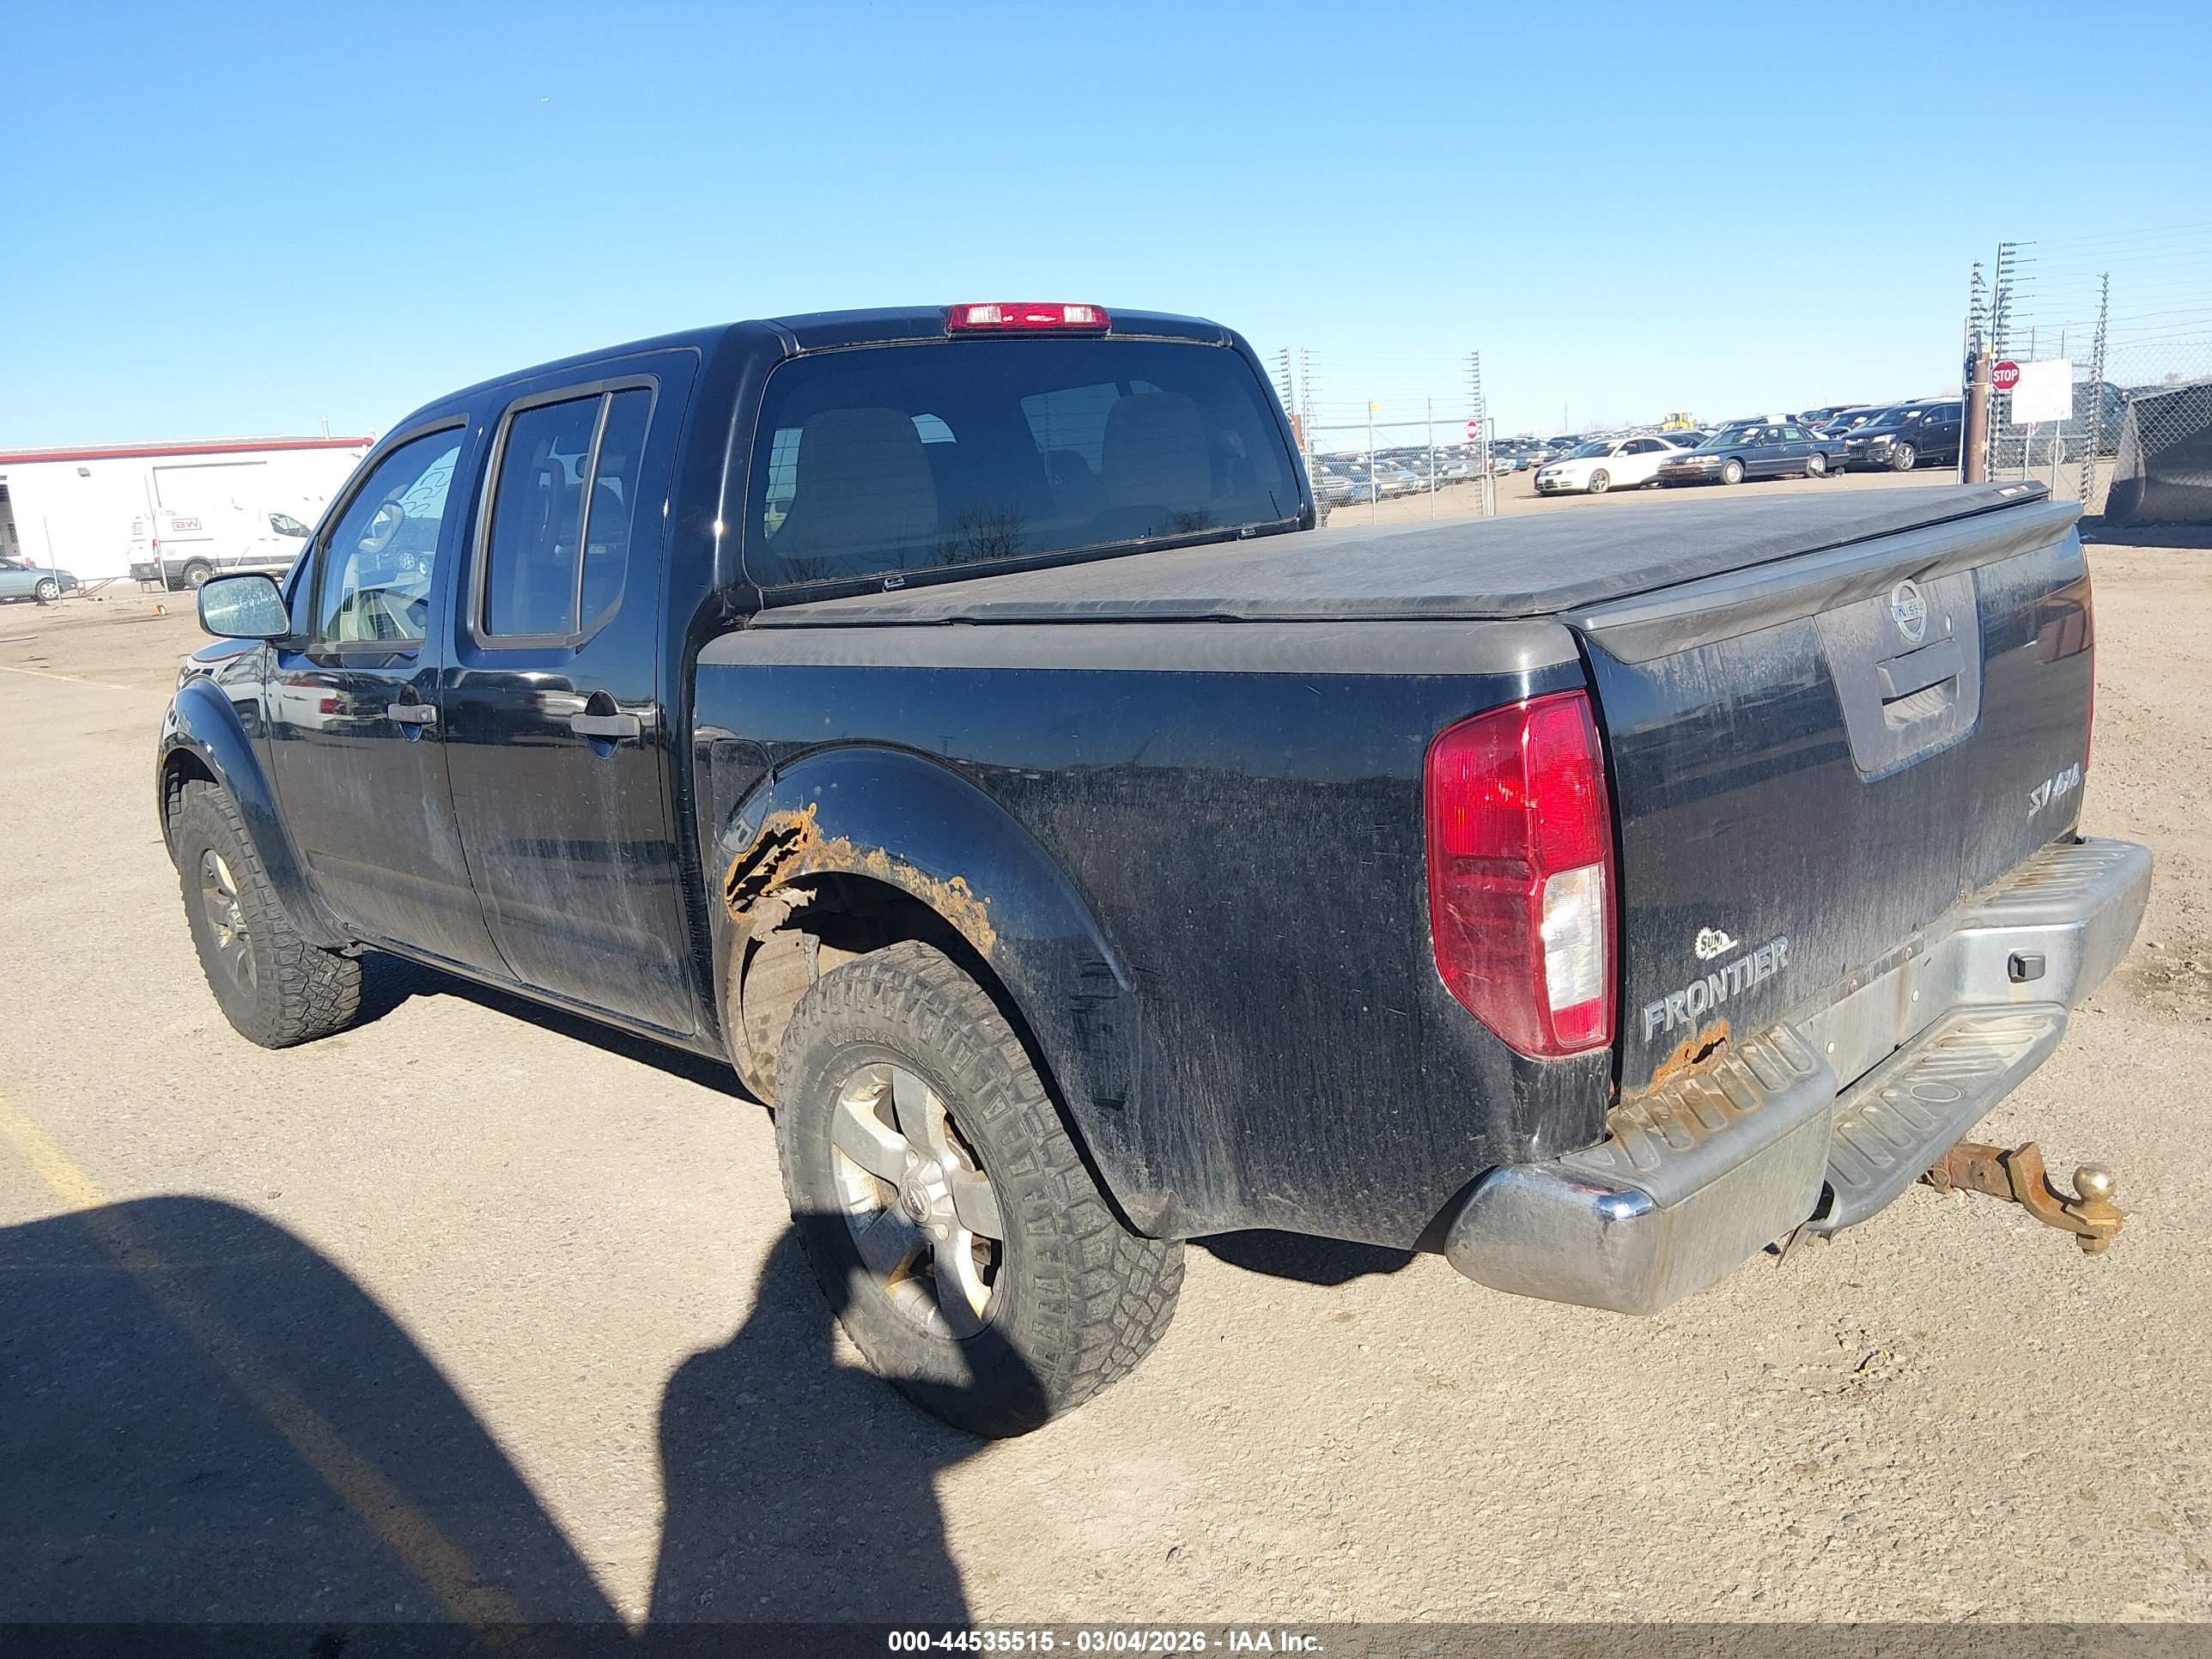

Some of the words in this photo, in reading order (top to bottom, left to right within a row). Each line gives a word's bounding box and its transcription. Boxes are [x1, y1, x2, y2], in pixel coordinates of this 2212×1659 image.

[1993, 368, 2019, 382] STOP
[1898, 603, 1924, 617] NISS
[2027, 778, 2052, 818] SV
[1700, 932, 1722, 952] SUN
[1641, 935, 1789, 1042] FRONTIER
